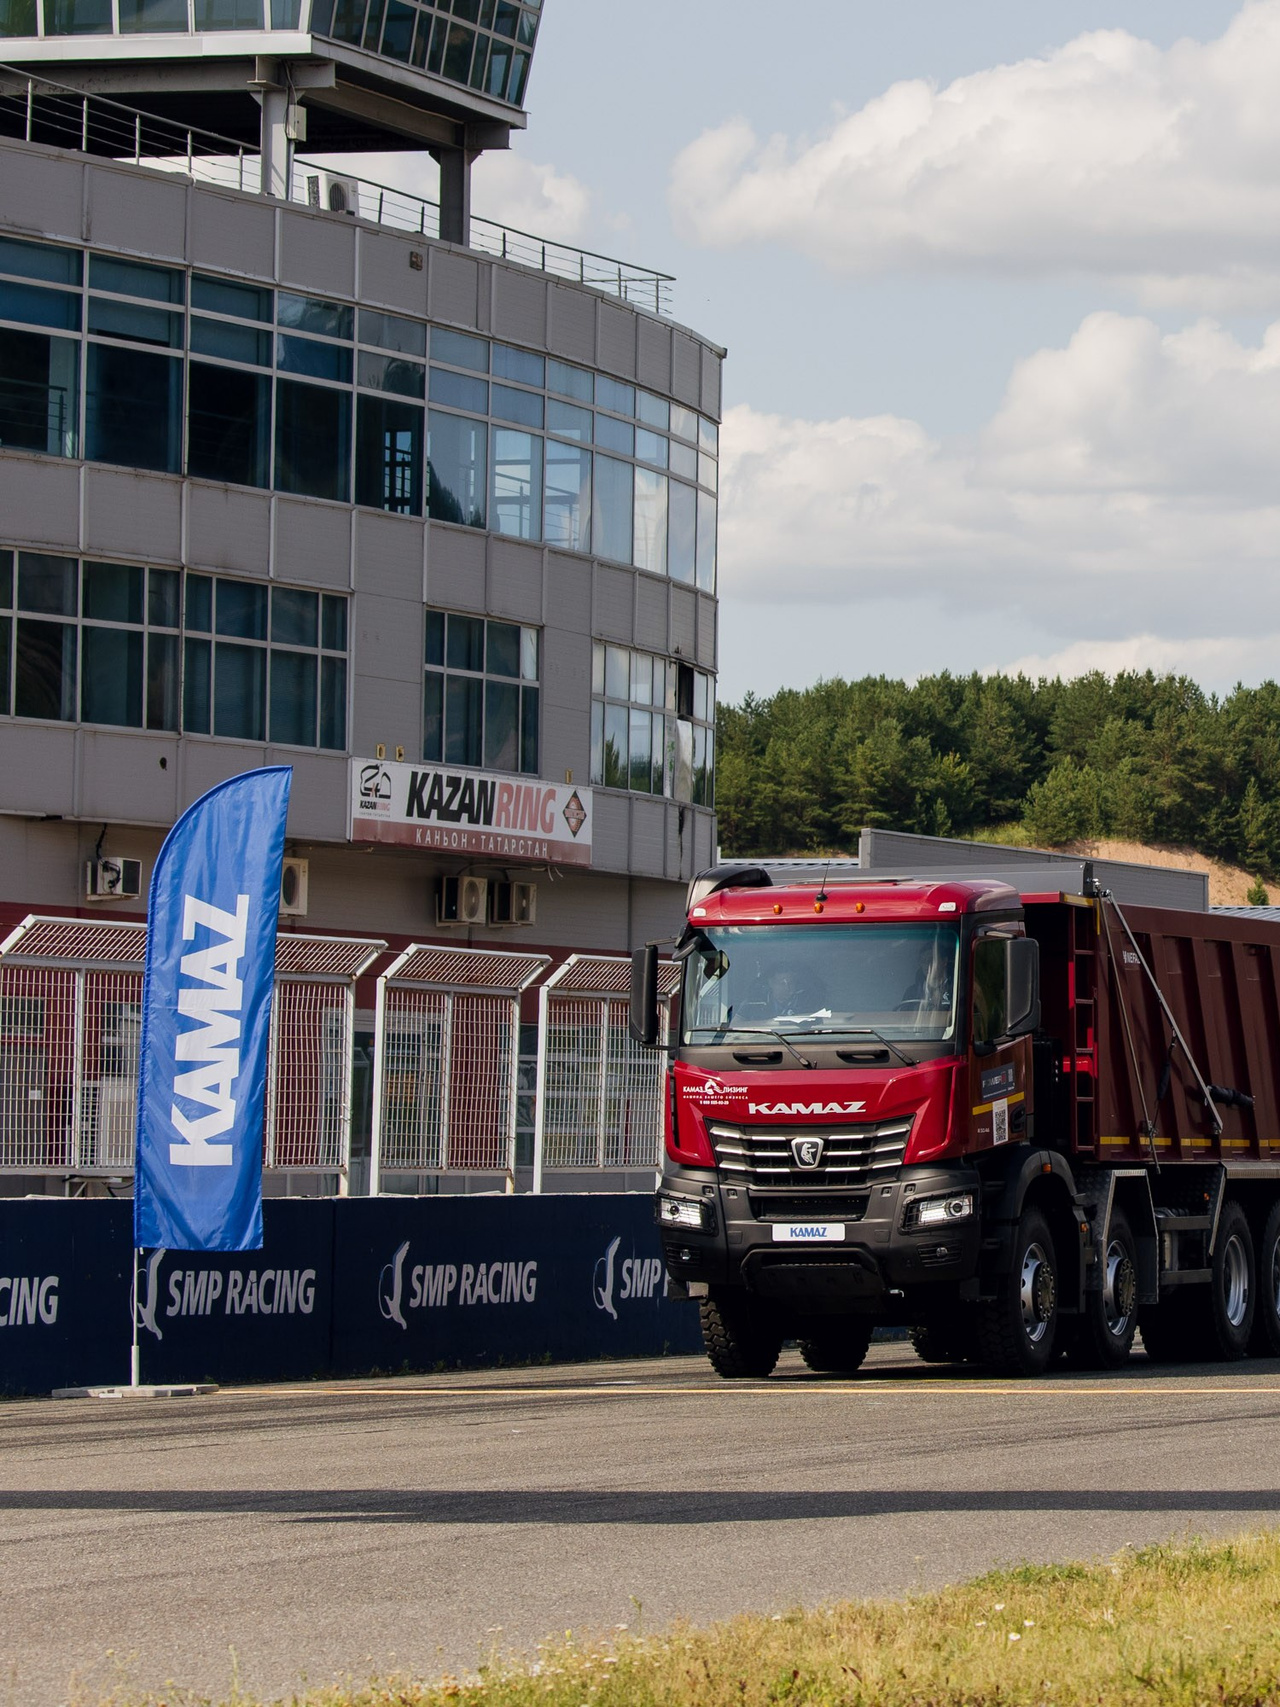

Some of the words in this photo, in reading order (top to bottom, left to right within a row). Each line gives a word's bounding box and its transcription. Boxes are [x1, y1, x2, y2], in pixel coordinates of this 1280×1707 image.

[415, 829, 468, 847] КАНЬОН
[481, 836, 548, 857] ТАТАРСТАН
[169, 894, 250, 1166] KAMAZ
[748, 1101, 866, 1114] KAMAZ
[790, 1227, 827, 1237] KAMAZ
[166, 1270, 223, 1316] SMP
[225, 1269, 316, 1314] RACING
[409, 1265, 457, 1308] SMP
[459, 1261, 537, 1305] RACING
[620, 1258, 662, 1299] SMP
